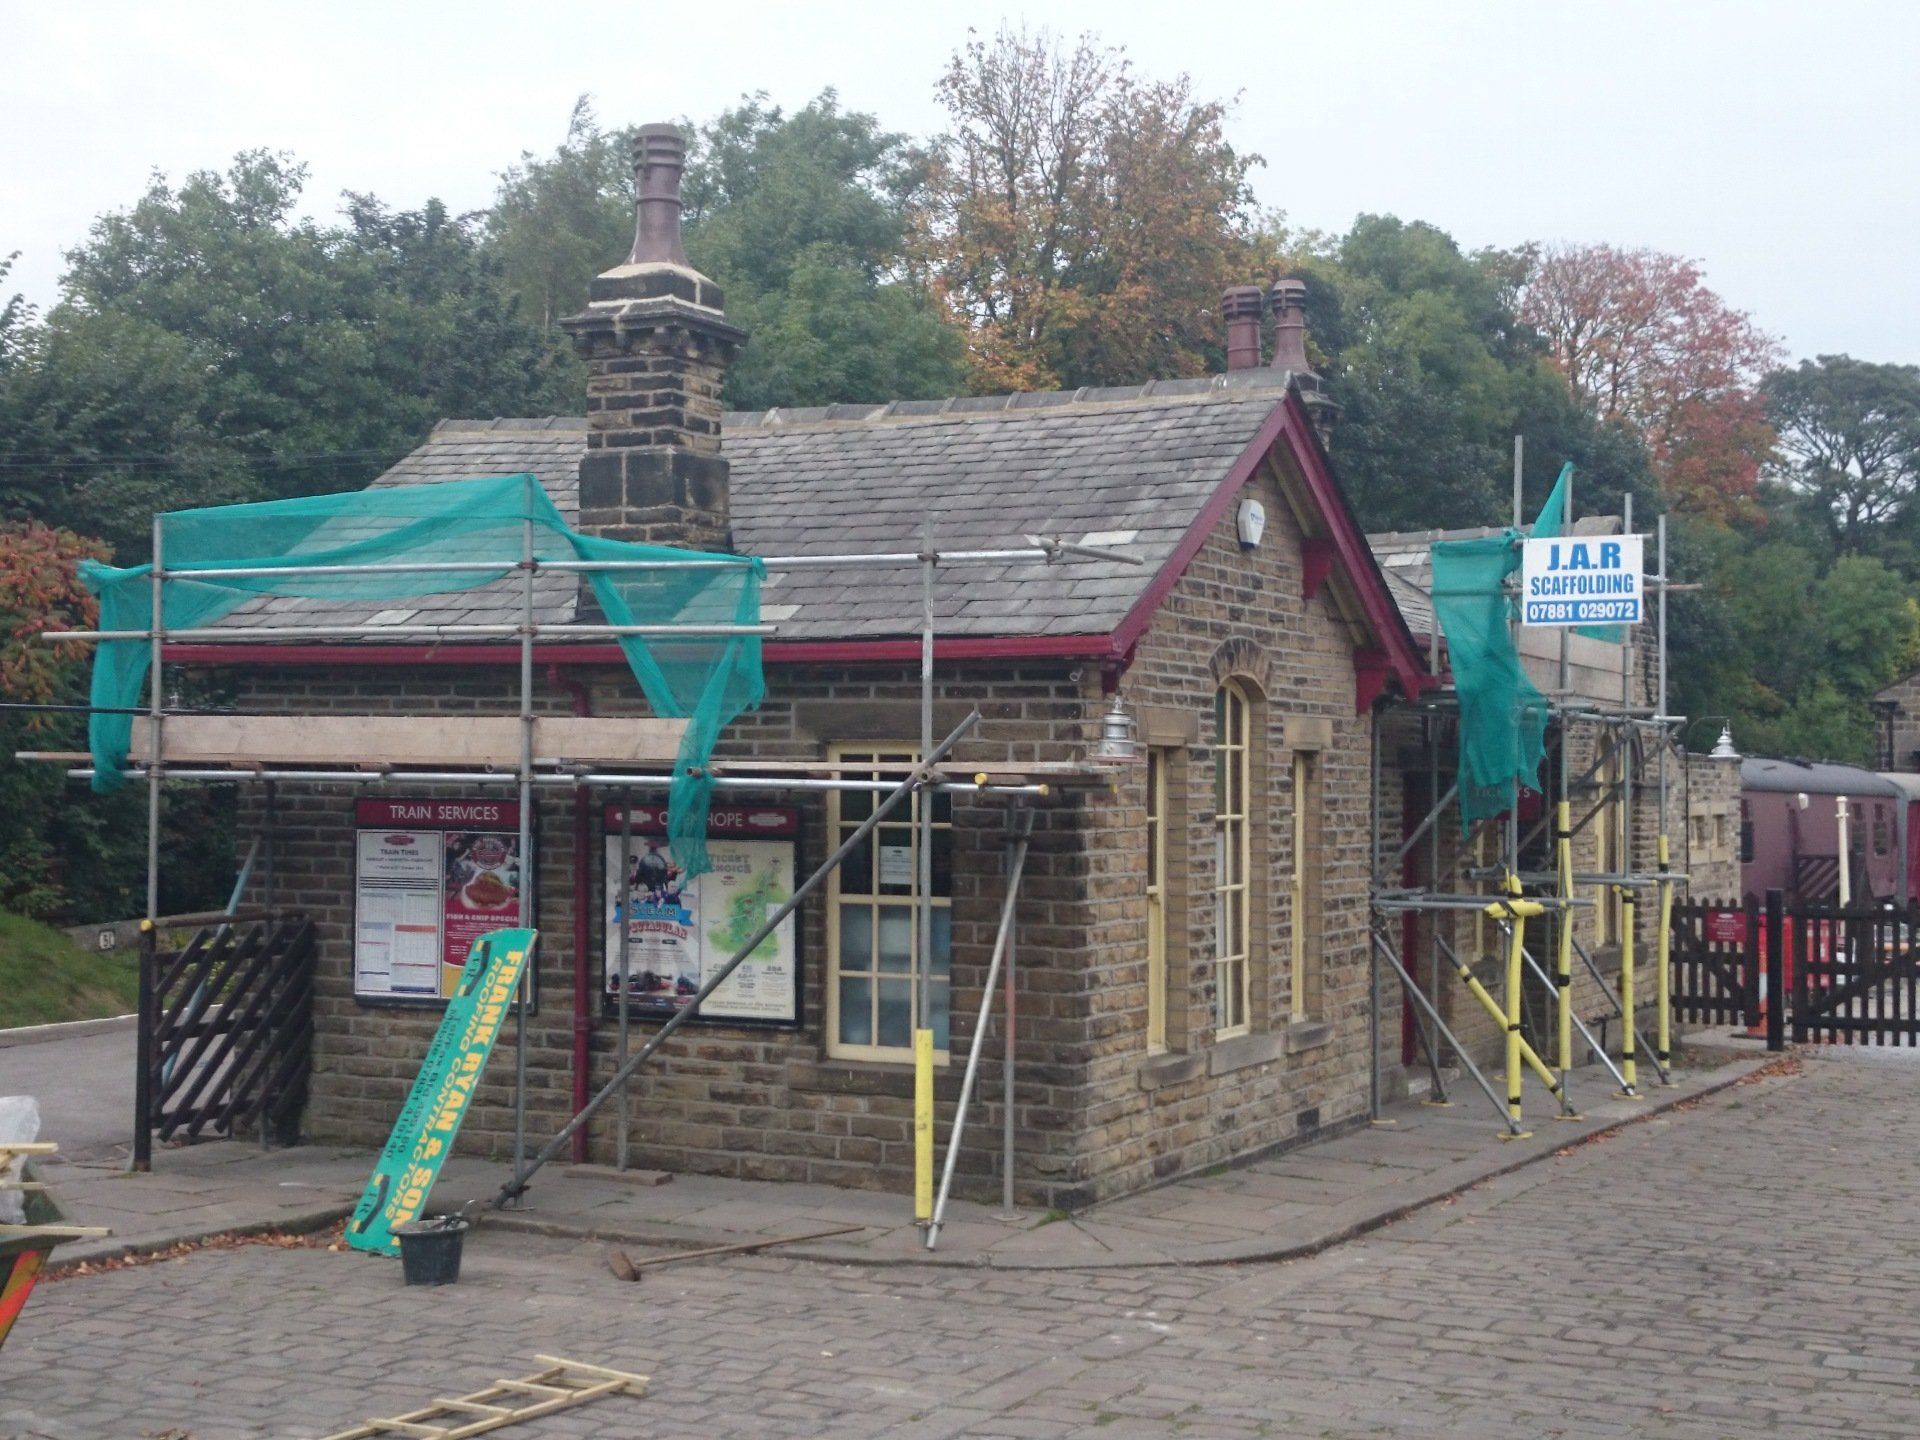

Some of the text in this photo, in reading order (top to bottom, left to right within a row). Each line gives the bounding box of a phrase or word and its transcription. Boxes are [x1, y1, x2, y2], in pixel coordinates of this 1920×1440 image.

[1547, 542, 1621, 571] J.A.R
[1530, 573, 1634, 596] SCAFFOLDING
[1529, 602, 1635, 619] 07881 029072
[389, 805, 499, 821] TRAIN SERVICES
[459, 956, 503, 1052] ROOFING
[472, 951, 524, 1046] FRANK
[435, 1052, 482, 1131] RYAN
[385, 1057, 461, 1219] CONTRACTORS
[423, 1137, 442, 1160] &
